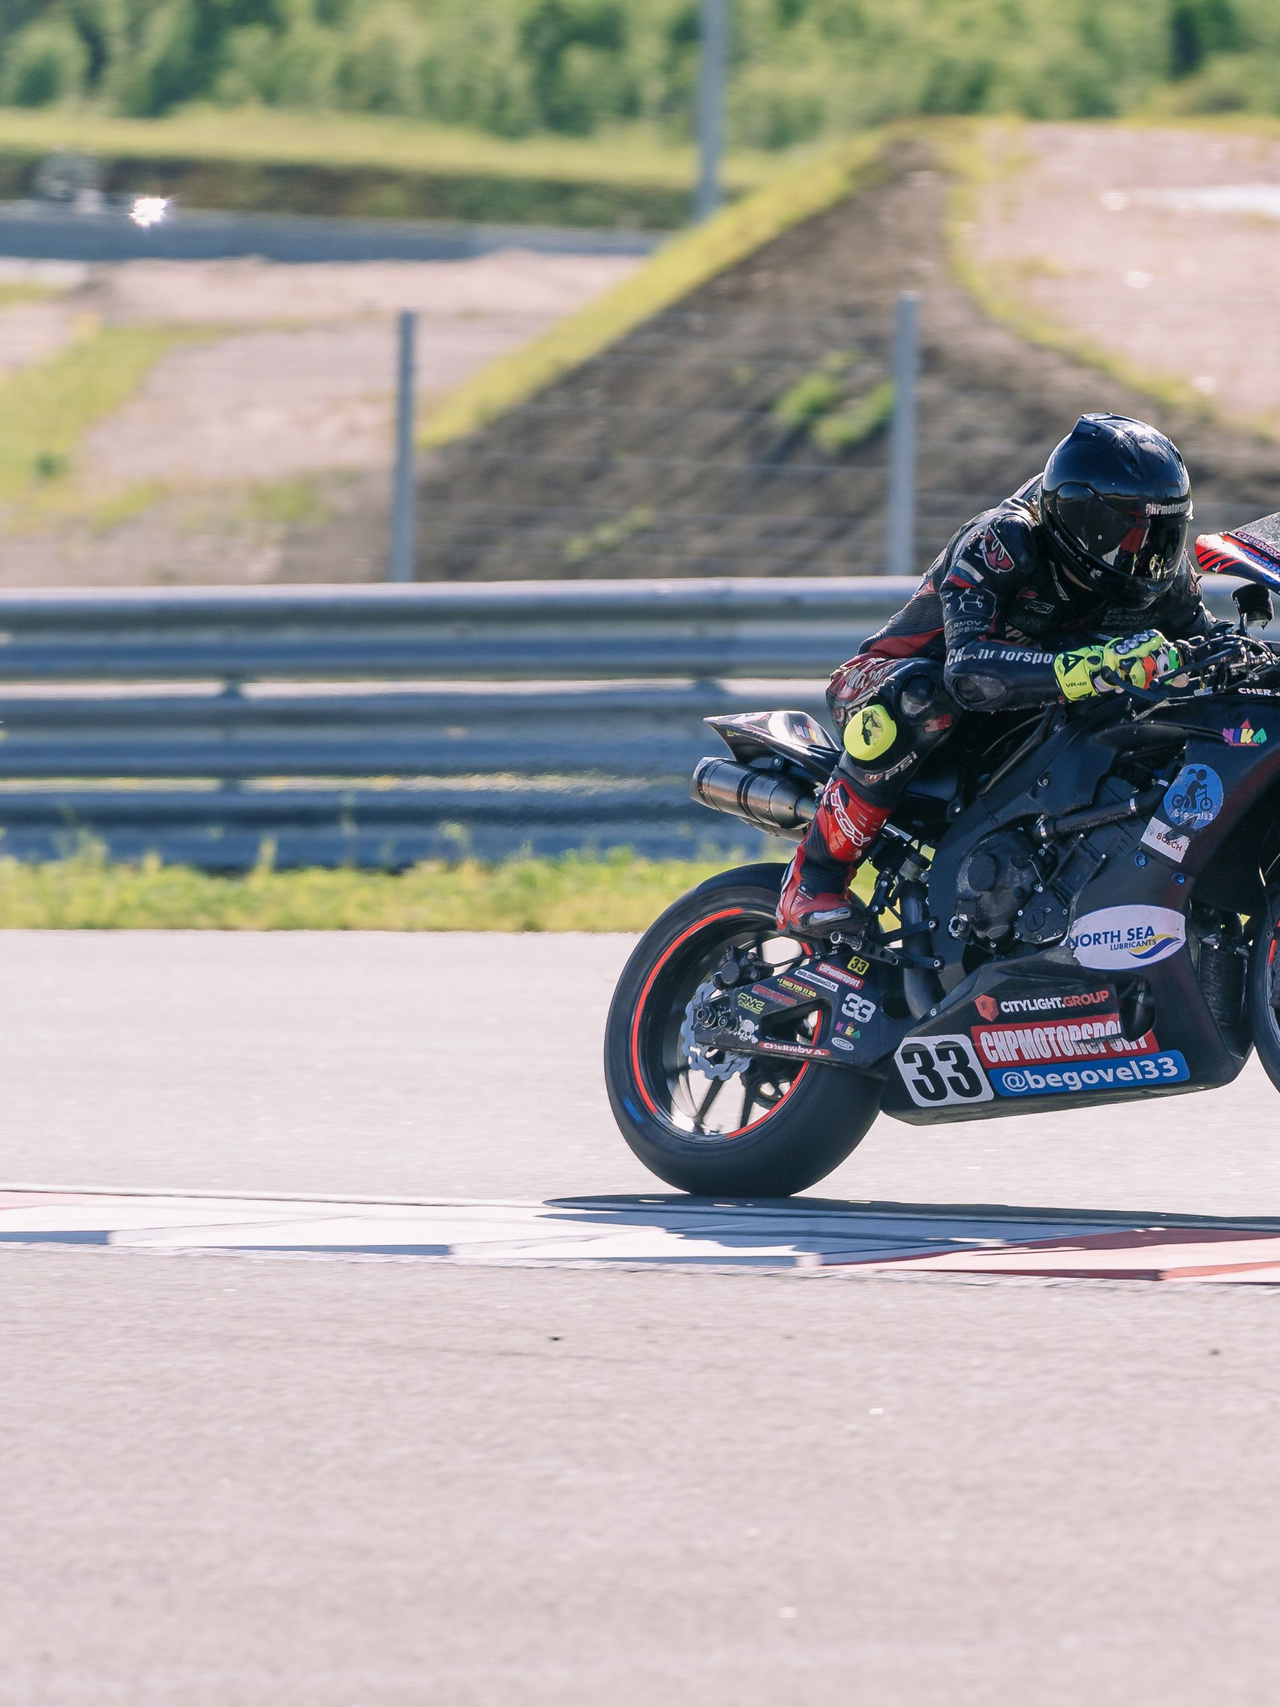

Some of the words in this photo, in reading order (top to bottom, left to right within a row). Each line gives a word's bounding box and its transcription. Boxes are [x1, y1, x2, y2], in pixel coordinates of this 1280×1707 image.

[1068, 929, 1122, 950] NORTH
[1126, 925, 1156, 942] SEA
[1109, 938, 1157, 952] LUBRICANTS
[850, 957, 866, 974] 33
[737, 992, 766, 1012] RMC
[841, 992, 877, 1024] 33
[1000, 990, 1110, 1014] CITYLIGHT.GROUP
[901, 1040, 984, 1101] 33
[1002, 1056, 1179, 1093] @begovel33
